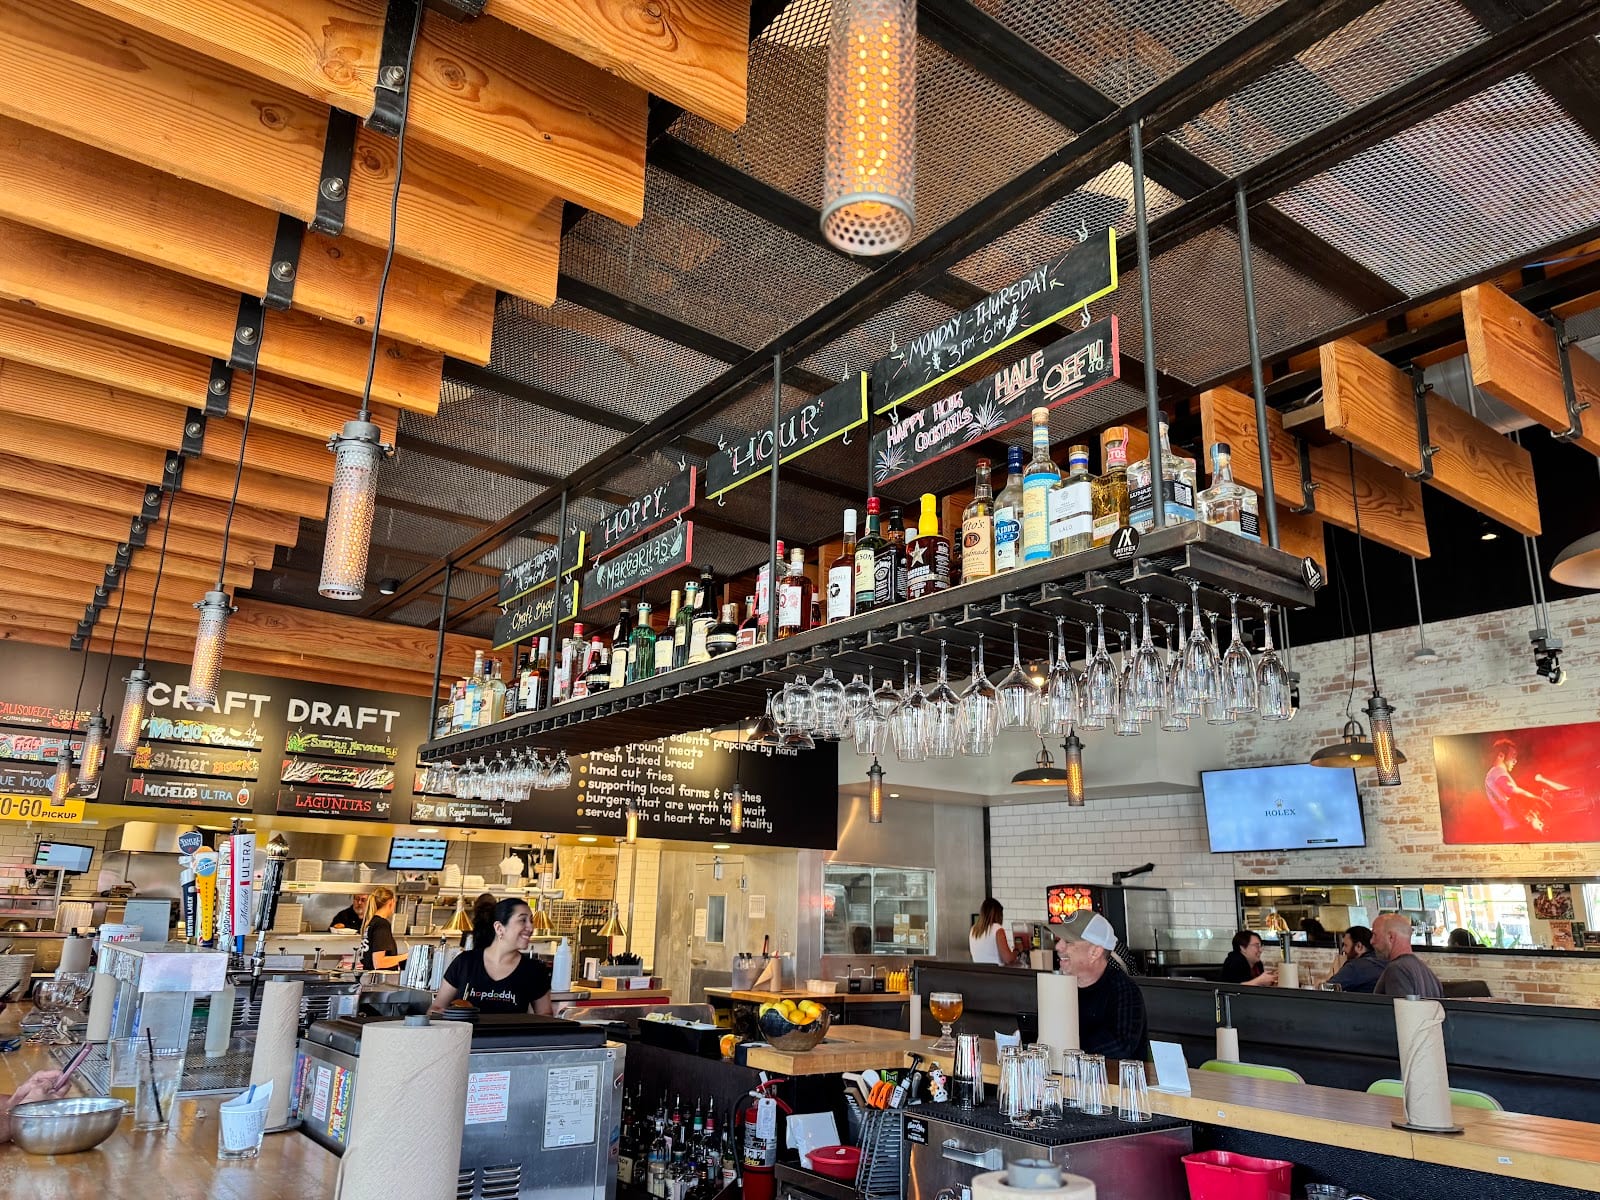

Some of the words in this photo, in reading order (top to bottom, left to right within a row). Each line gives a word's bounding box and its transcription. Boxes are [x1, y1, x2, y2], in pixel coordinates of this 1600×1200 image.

[994, 350, 1044, 402] HALF
[886, 408, 926, 448] HAPPY
[933, 391, 964, 421] HOUR
[914, 406, 974, 452] COCKTAILS
[1129, 486, 1152, 499] LUNAZ
[856, 551, 873, 561] ESON
[287, 698, 400, 733] DRAFT
[148, 720, 203, 740] Modelo
[668, 746, 704, 758] meats
[713, 740, 758, 753] prepared
[760, 746, 773, 757] by
[775, 744, 798, 757] hand
[152, 752, 209, 772] Shiner
[589, 750, 623, 763] fresh
[627, 751, 661, 767] baked
[664, 756, 695, 770] bread
[588, 762, 618, 777] hand
[621, 766, 642, 778] cut
[646, 767, 674, 782] fries
[143, 783, 198, 799] MICHELOB
[200, 789, 233, 801] ULTRA
[587, 780, 647, 796] supporting
[649, 782, 676, 796] local
[678, 783, 711, 799] farms
[713, 787, 721, 800] &
[0, 797, 42, 817] O-GO
[41, 811, 77, 820] PICKUP
[295, 794, 372, 812] LAGUNITAS
[585, 790, 631, 808] burgers
[636, 796, 661, 808] that
[665, 801, 684, 810] are
[687, 800, 719, 812] worth
[743, 805, 767, 817] wait
[1265, 808, 1297, 817] ROLEX
[585, 807, 622, 819] served
[625, 810, 650, 821] wth
[653, 812, 661, 821] a
[664, 812, 694, 824] heart
[698, 813, 716, 825] for
[719, 814, 773, 833] hoitality
[242, 840, 252, 878] ULTRA
